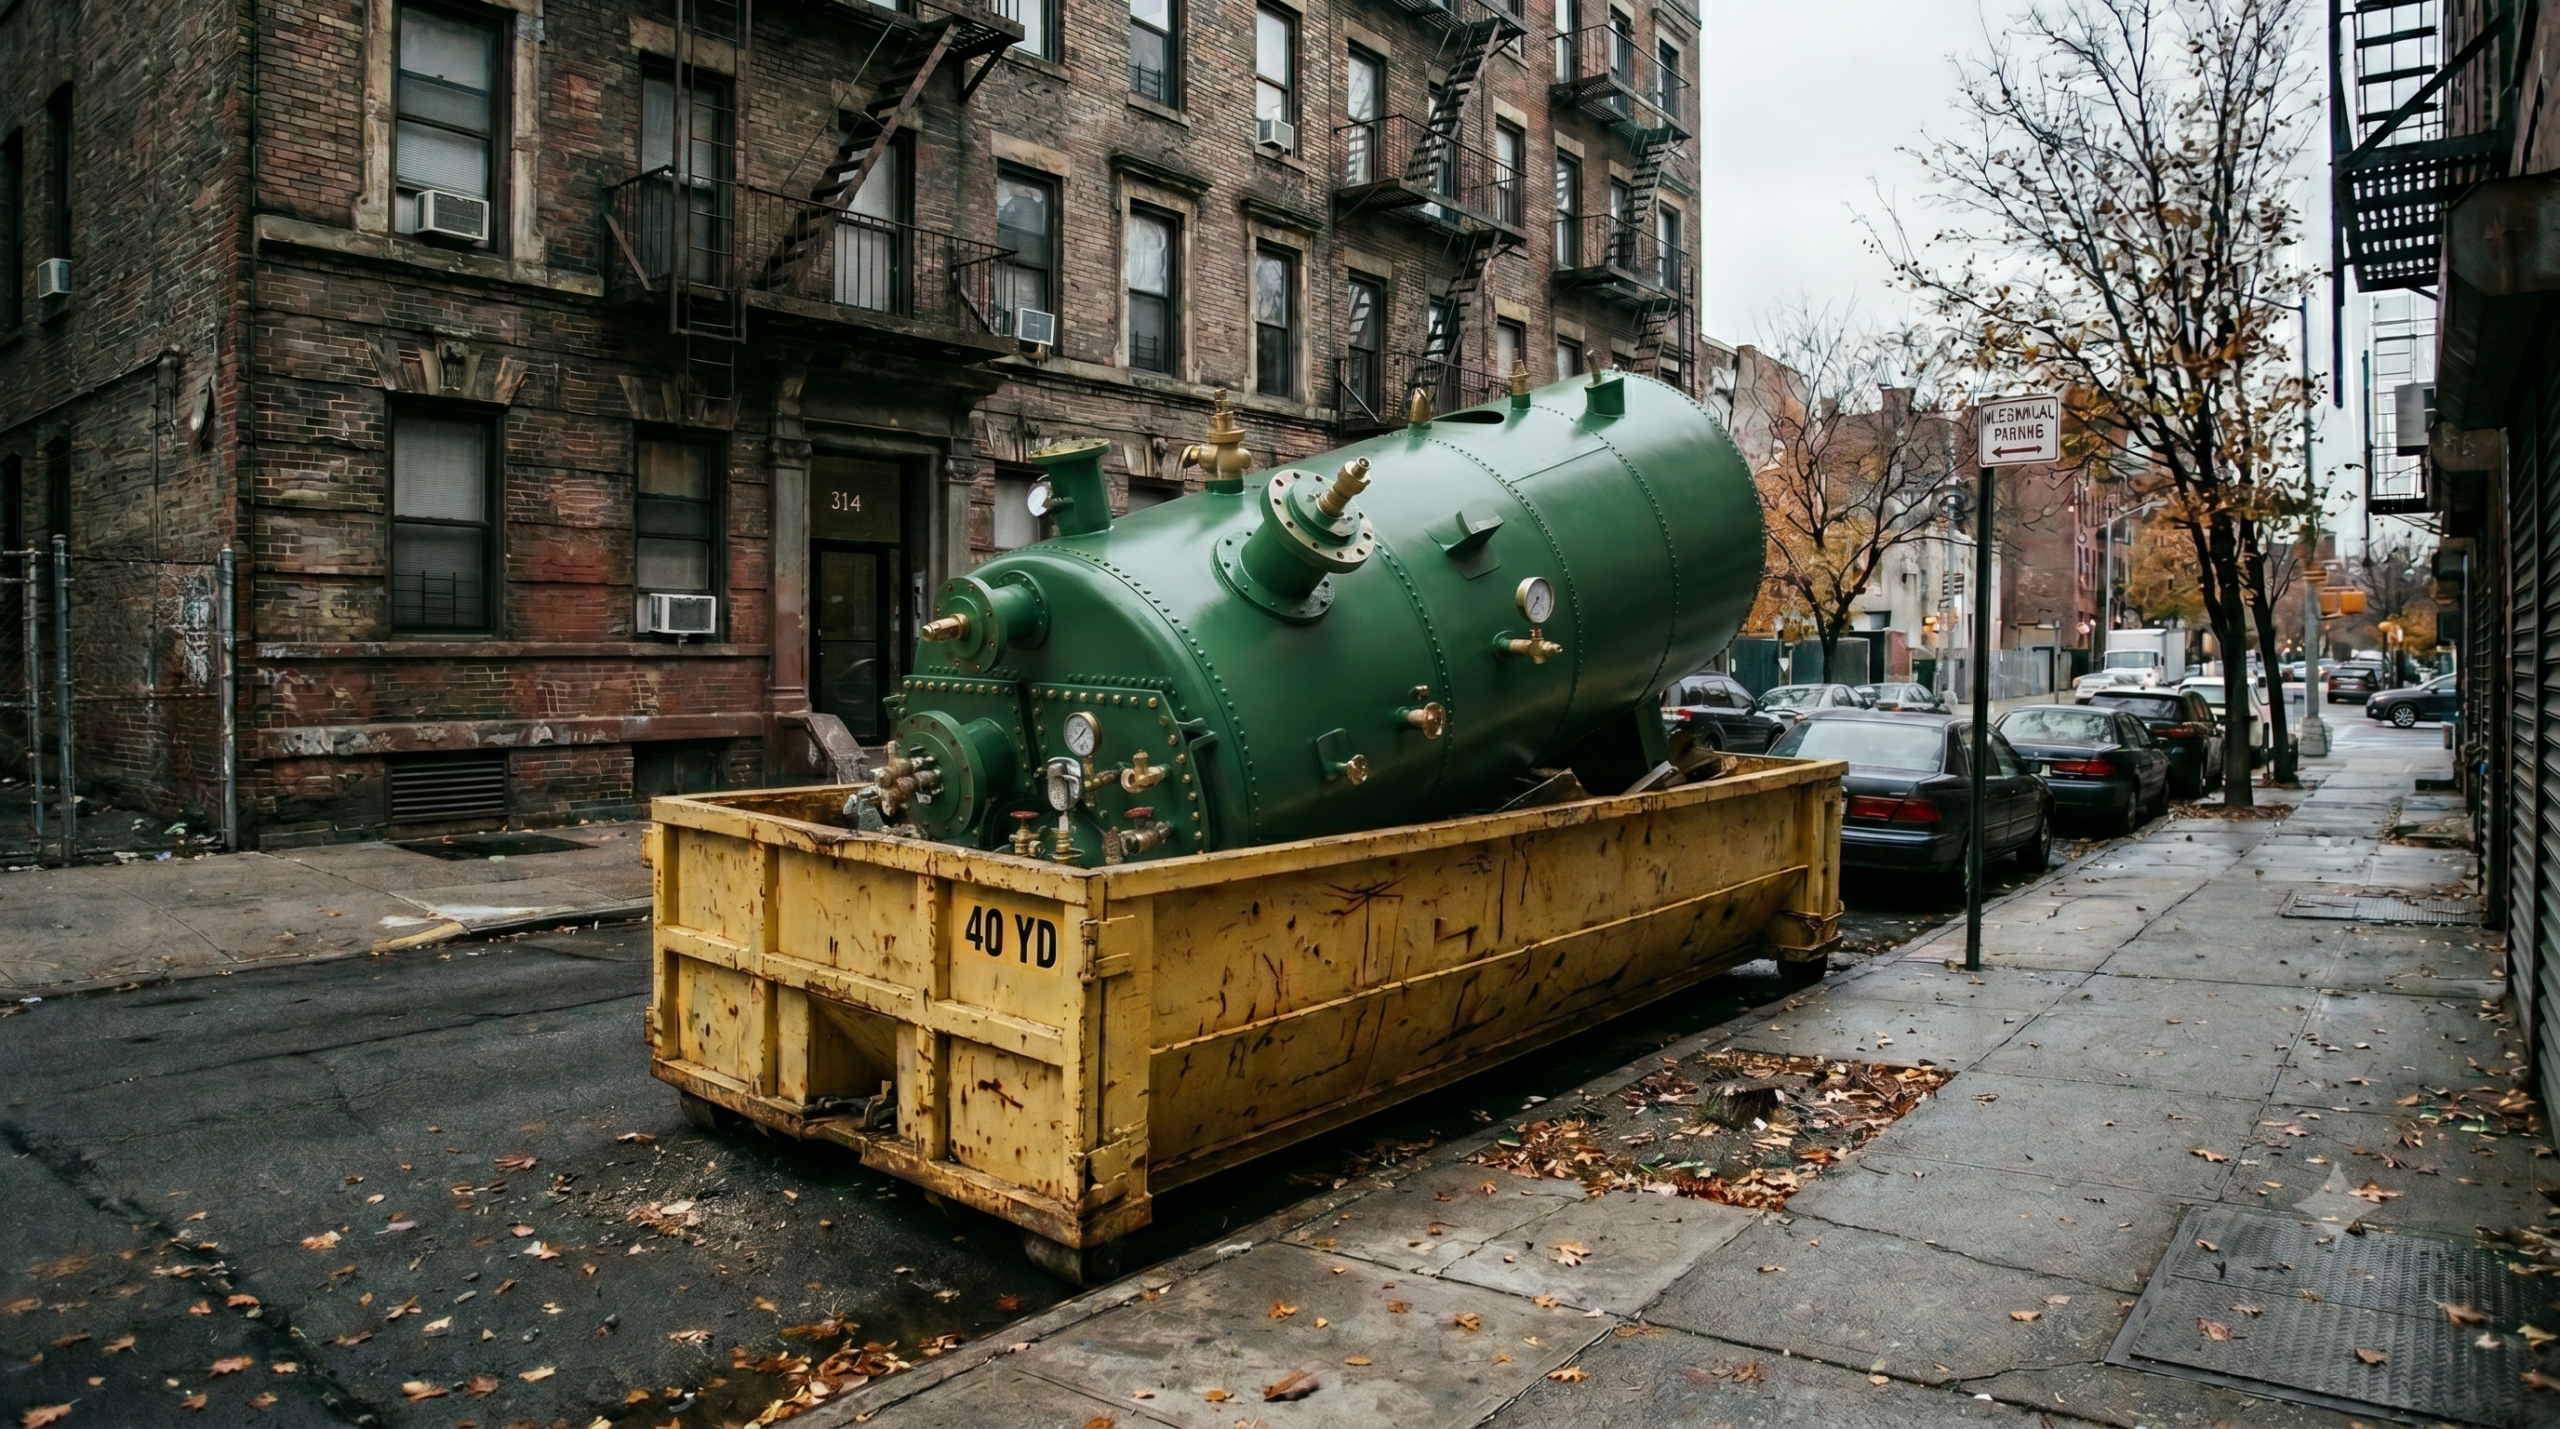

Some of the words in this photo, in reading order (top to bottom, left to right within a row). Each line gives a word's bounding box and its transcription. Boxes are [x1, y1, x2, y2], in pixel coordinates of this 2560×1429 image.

[831, 491, 861, 512] 314
[965, 905, 1003, 957] 40
[1014, 913, 1057, 969] YD
